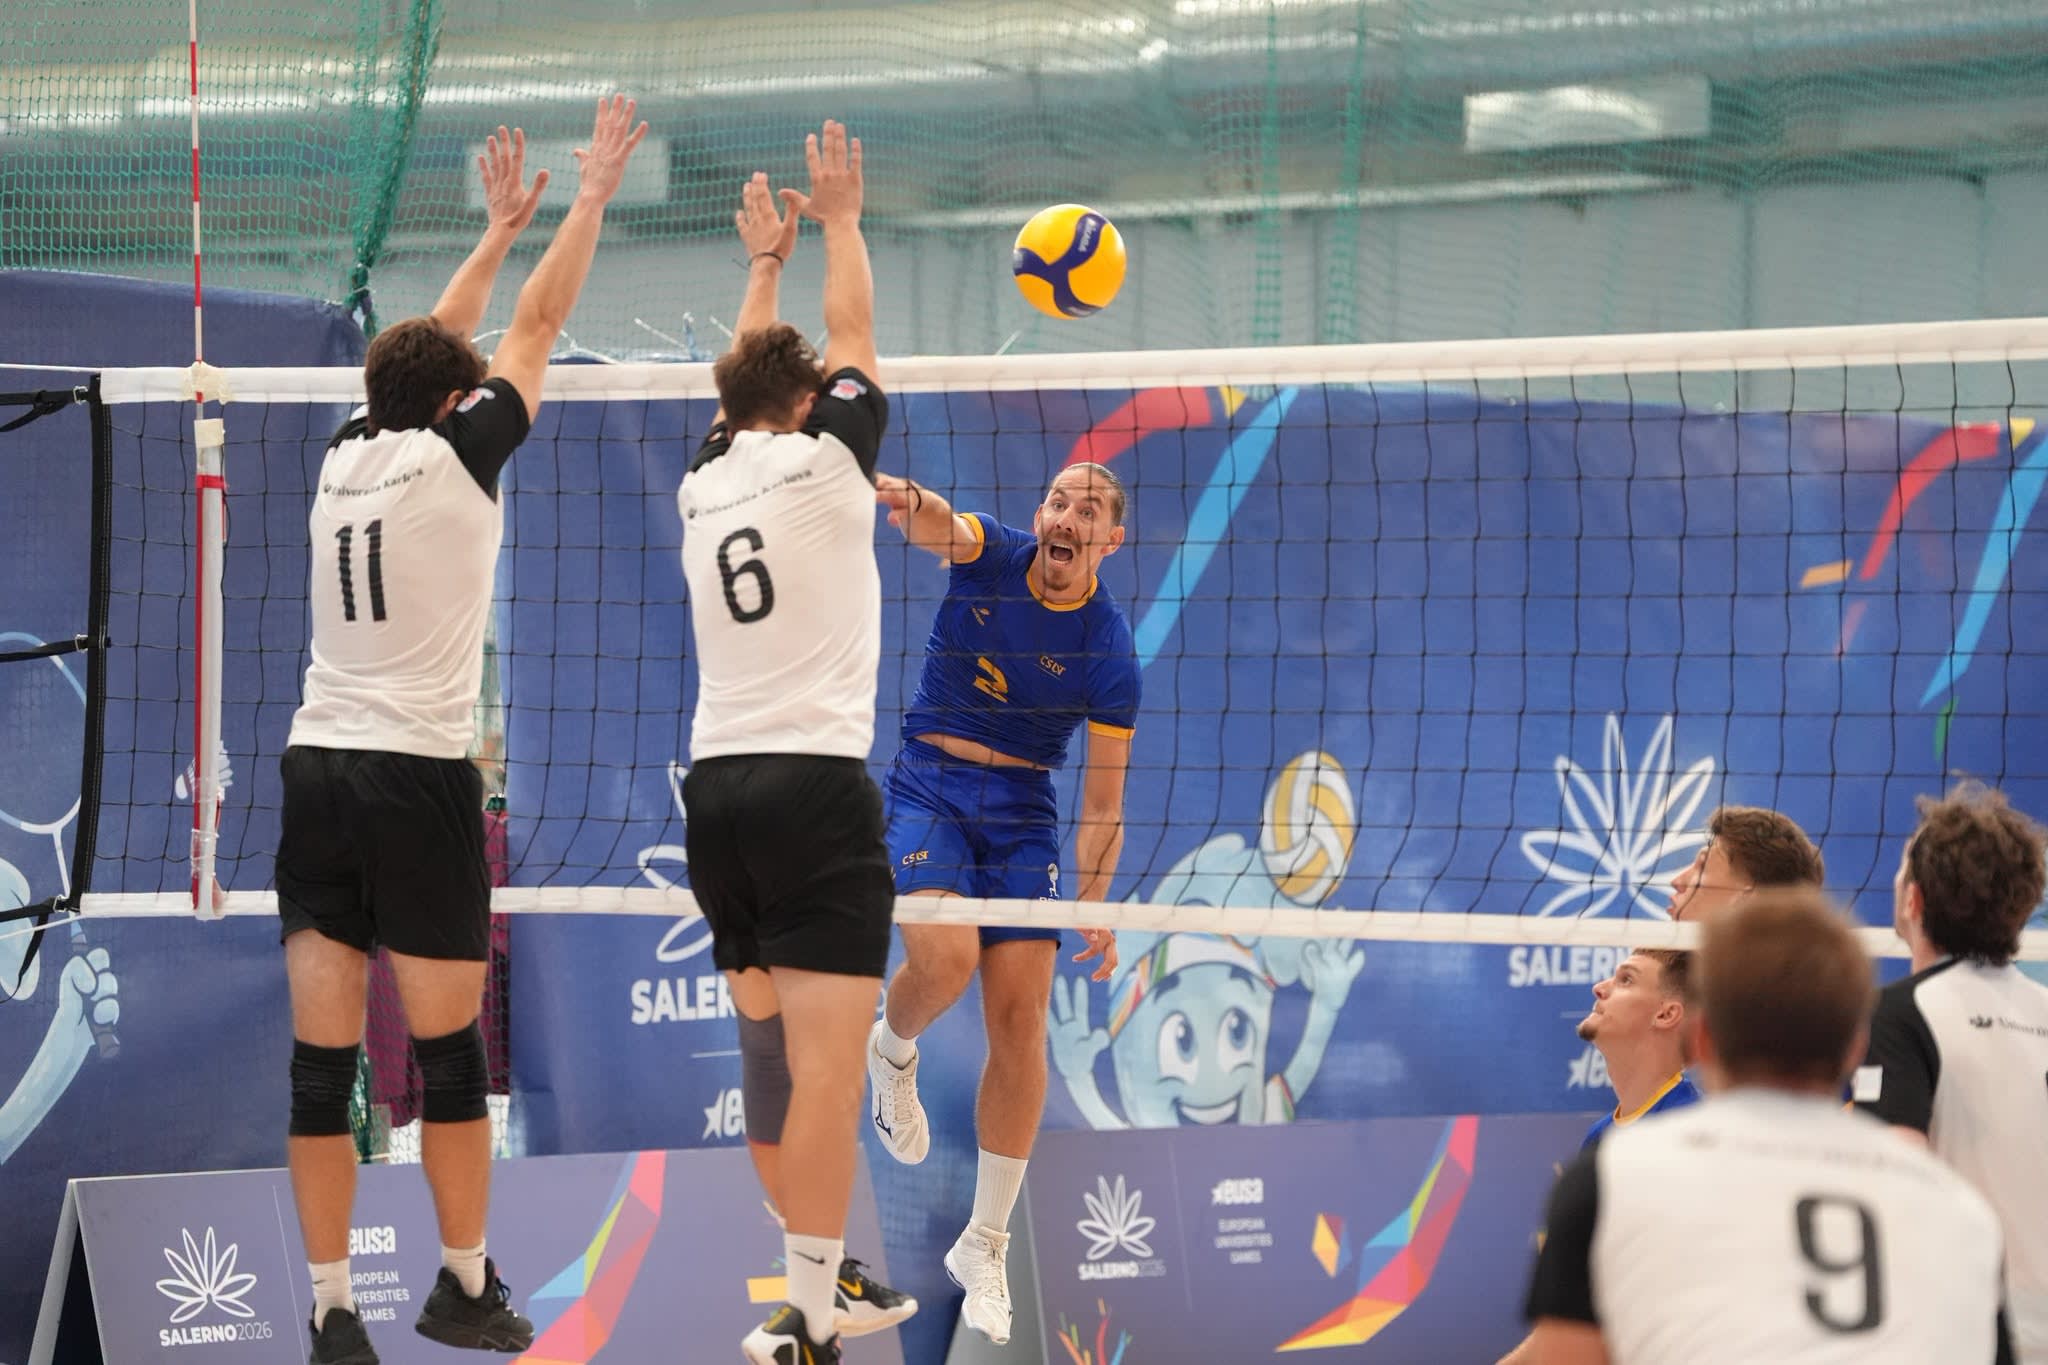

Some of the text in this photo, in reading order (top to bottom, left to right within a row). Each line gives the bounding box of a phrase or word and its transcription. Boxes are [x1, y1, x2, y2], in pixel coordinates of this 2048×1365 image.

[335, 518, 386, 622] 11
[717, 526, 775, 624] 6
[973, 655, 1009, 703] 2
[631, 974, 738, 1025] SALER
[348, 1226, 397, 1255] eusa
[350, 1271, 400, 1286] UROPEAN
[1795, 1195, 1884, 1335] 9
[352, 1288, 410, 1304] IVERSITIES
[159, 1321, 273, 1347] SALERNO2026
